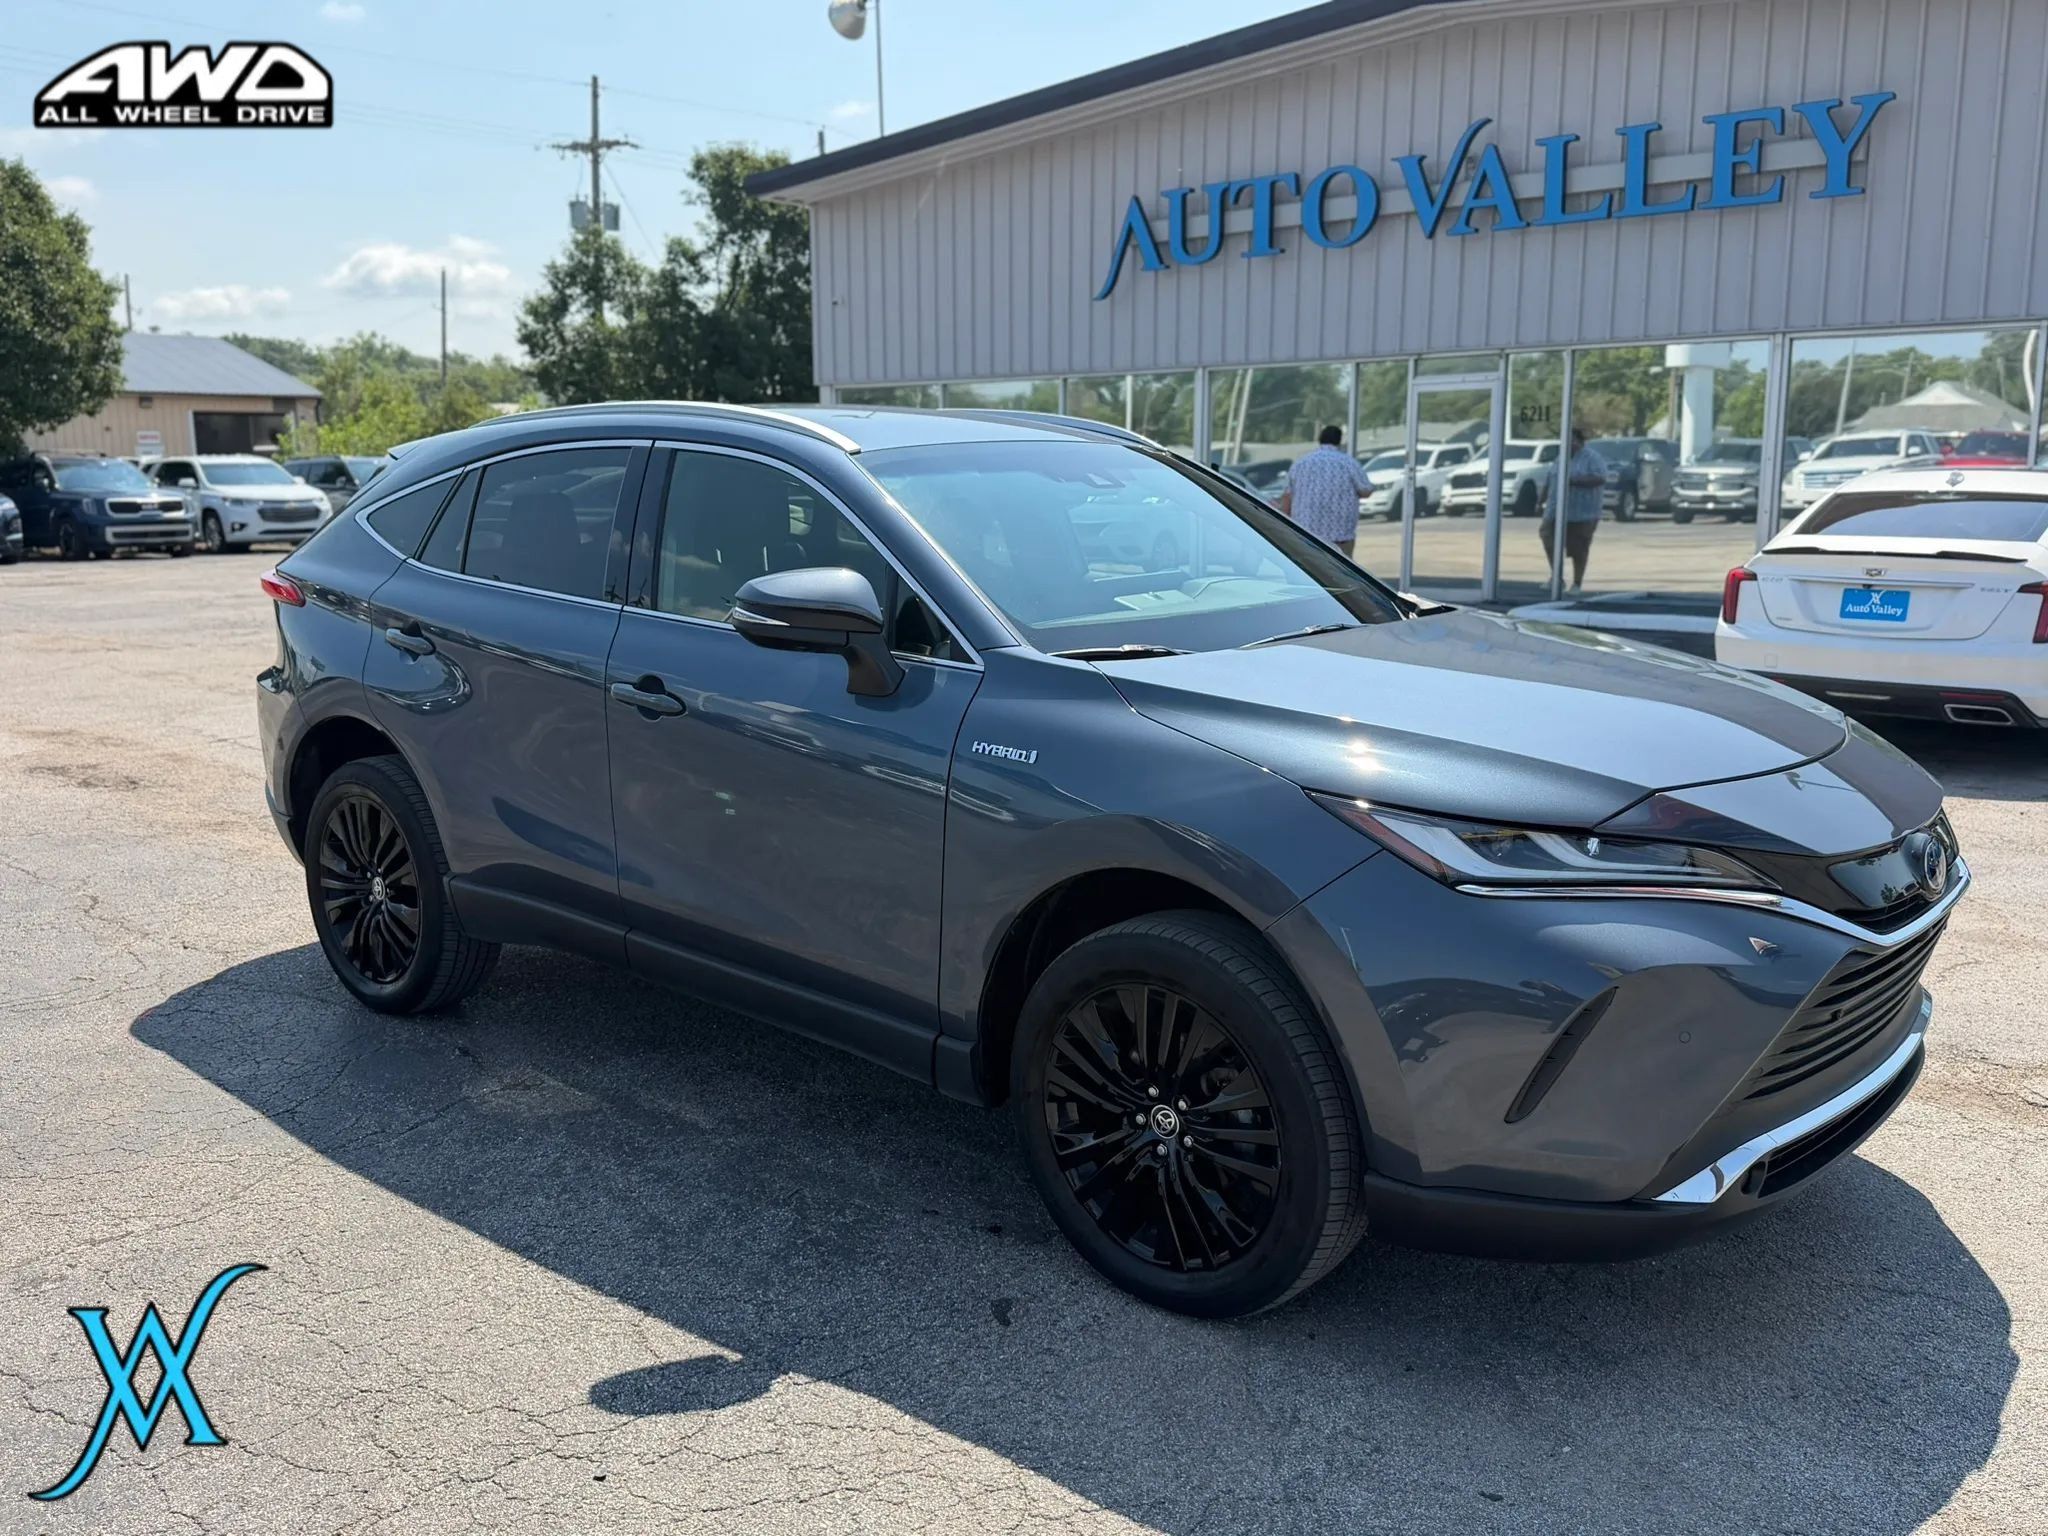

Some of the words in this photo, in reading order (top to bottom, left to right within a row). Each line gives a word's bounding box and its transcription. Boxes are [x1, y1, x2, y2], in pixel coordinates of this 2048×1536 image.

[1093, 164, 1380, 301] AUTO
[1391, 92, 1896, 239] VALLEY
[1845, 603, 1869, 613] Auto
[1871, 604, 1903, 617] Valley
[972, 740, 1028, 763] HYBRID
